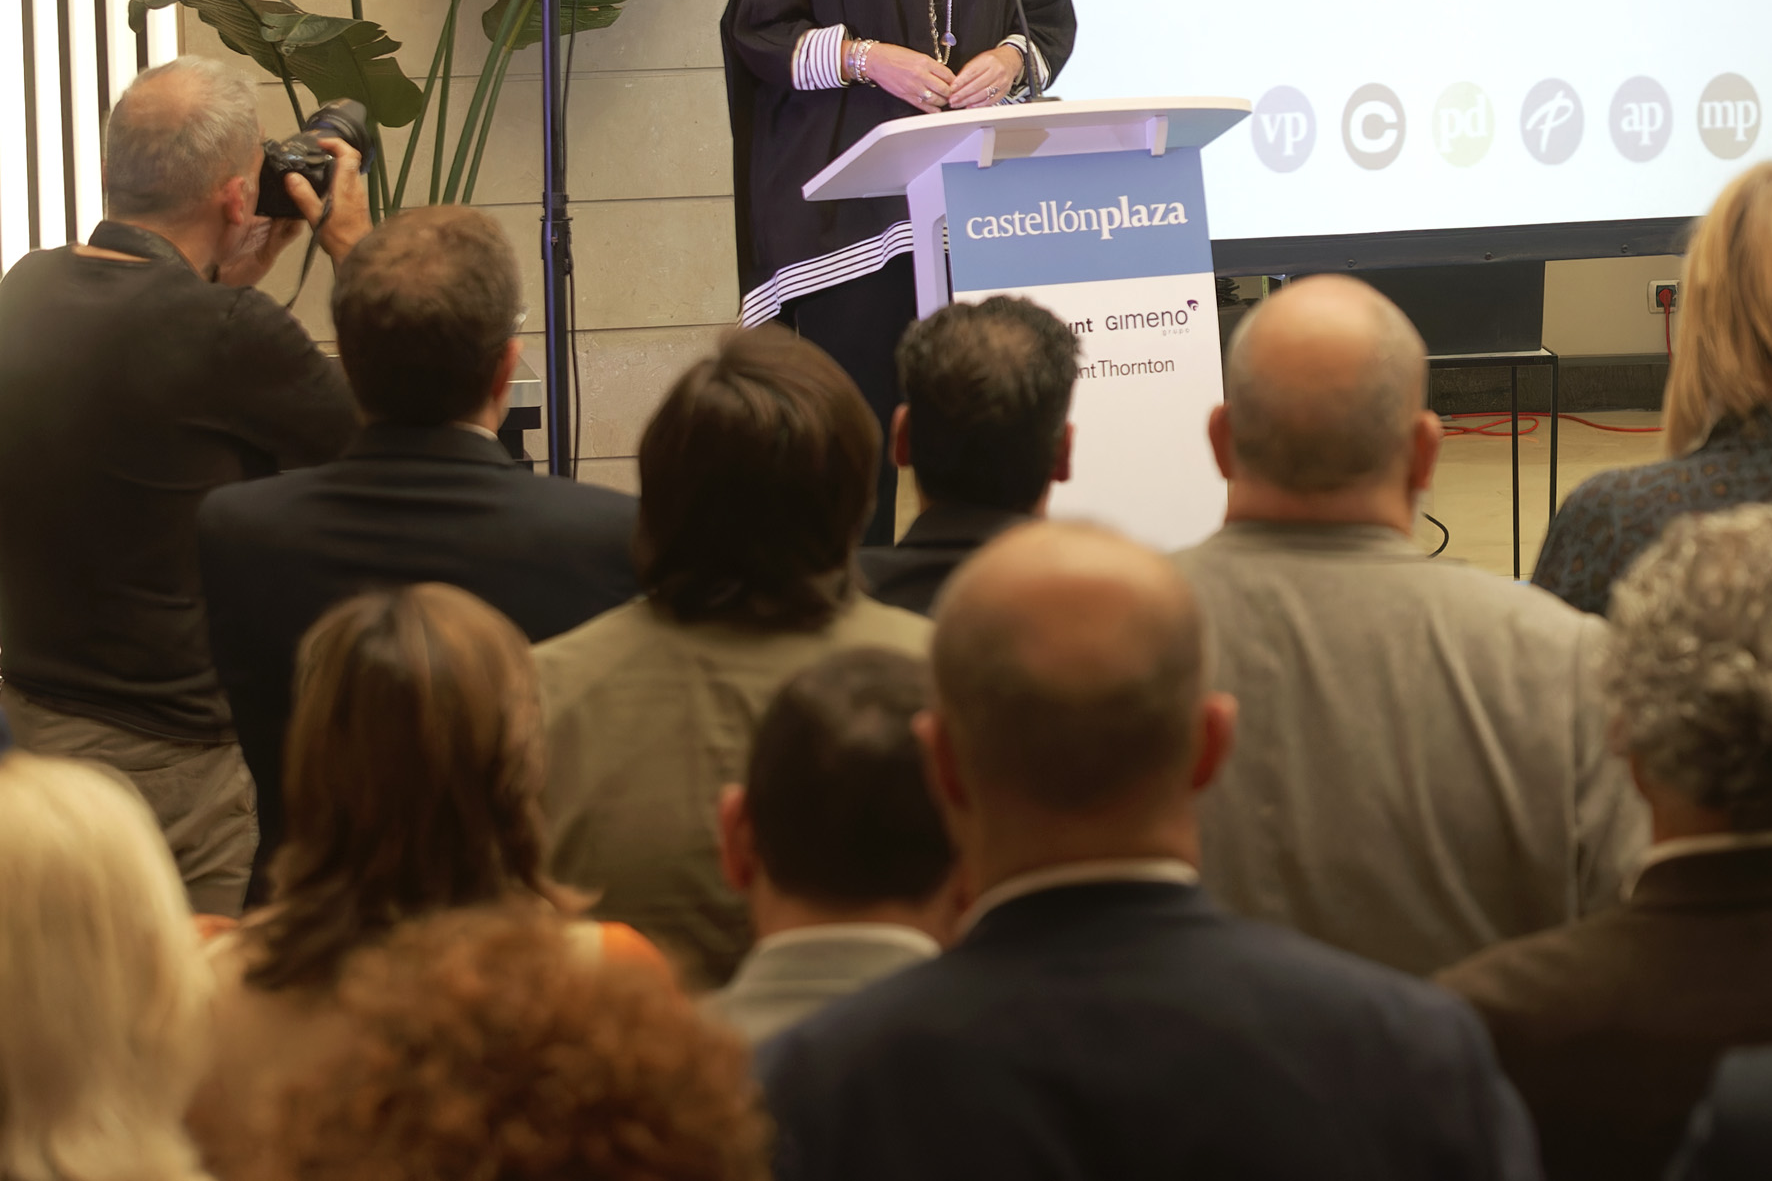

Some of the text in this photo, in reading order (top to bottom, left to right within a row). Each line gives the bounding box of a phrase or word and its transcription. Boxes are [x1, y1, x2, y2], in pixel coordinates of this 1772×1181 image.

[1260, 112, 1307, 156] vp
[1439, 94, 1488, 153] pd
[1620, 101, 1664, 146] ap
[1701, 98, 1758, 142] mp
[965, 195, 1189, 241] castellónplaza
[1162, 327, 1191, 337] grupo
